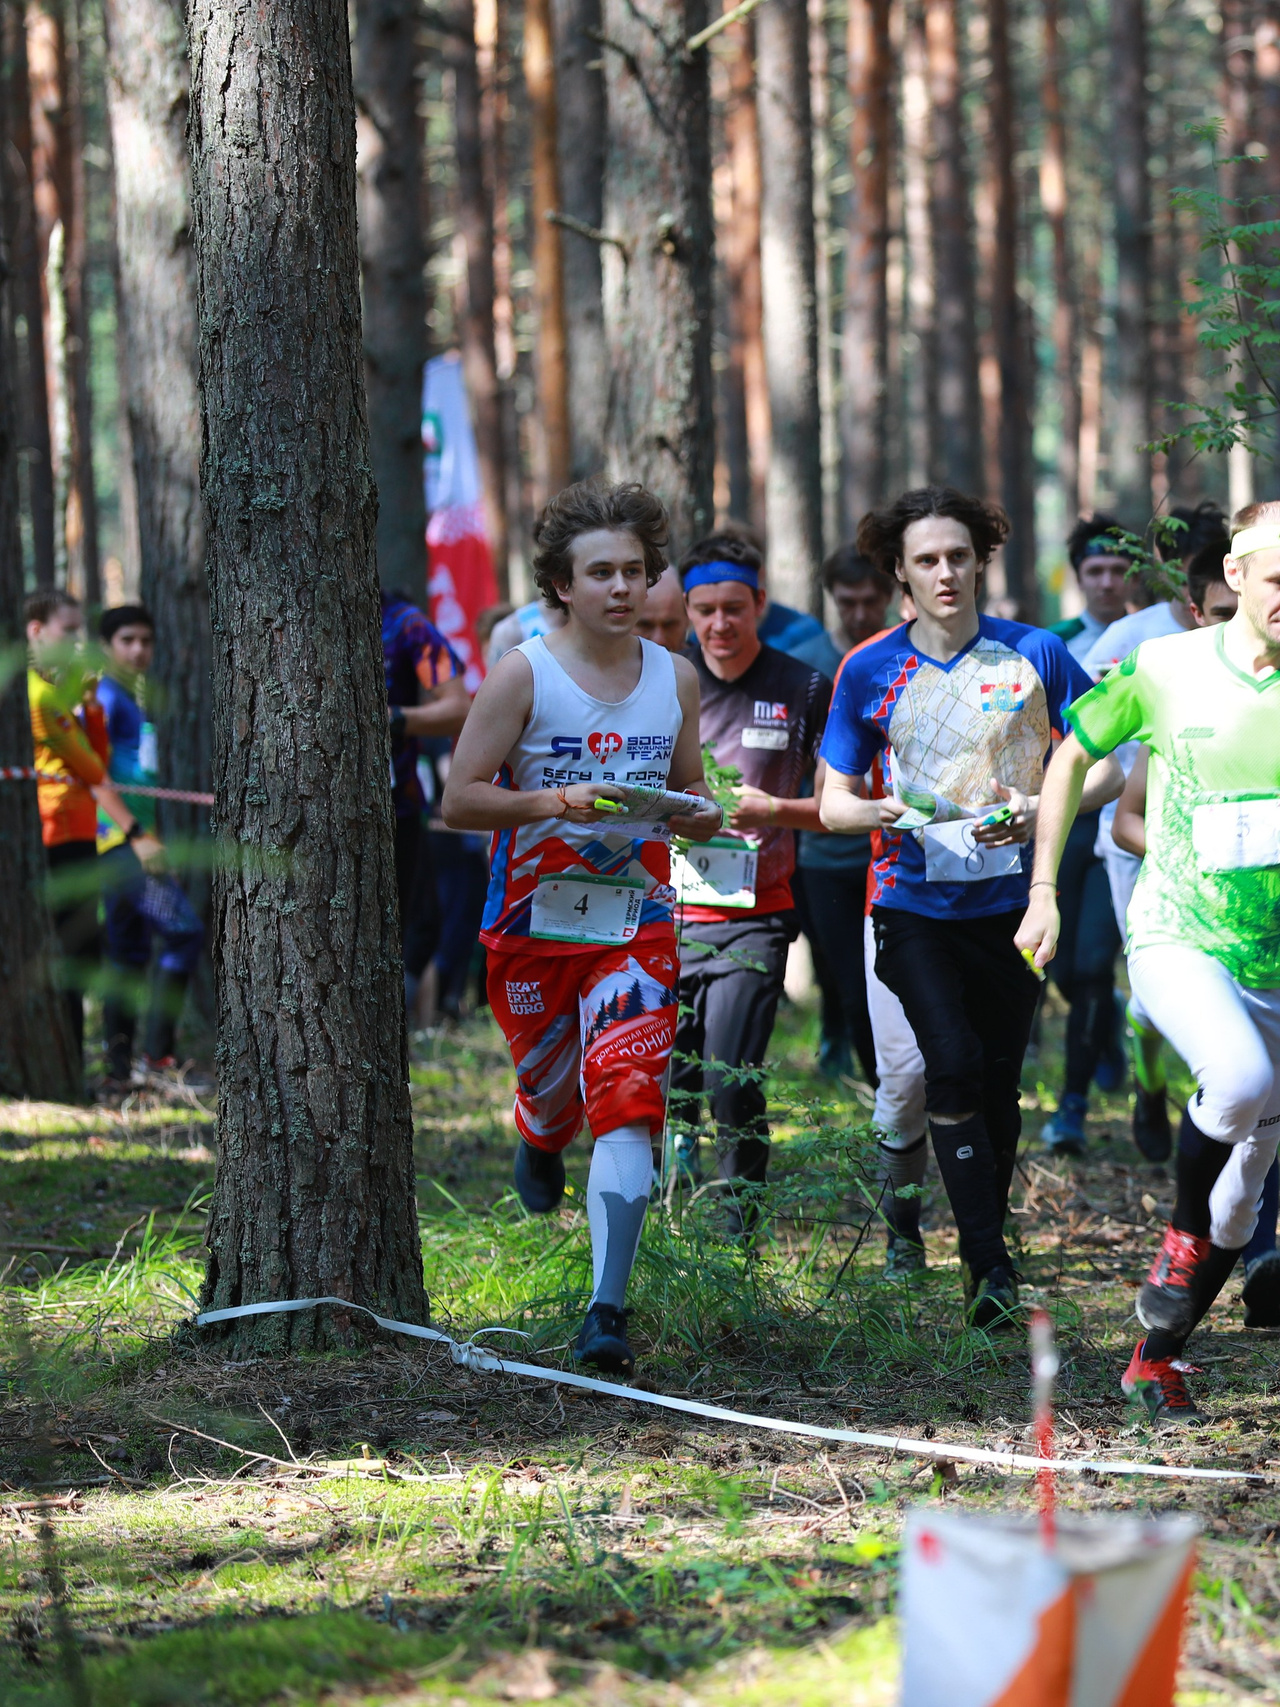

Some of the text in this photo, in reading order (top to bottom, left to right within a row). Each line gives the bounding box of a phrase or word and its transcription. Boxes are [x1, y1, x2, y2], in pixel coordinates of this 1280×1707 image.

[627, 735, 673, 746] SOCHI
[547, 736, 582, 760] Я
[627, 751, 671, 760] TEAM
[543, 767, 592, 781] БЕГУ
[603, 772, 616, 781] В
[574, 893, 589, 916] 4
[625, 889, 635, 925] ПЕРМСКИЙ
[631, 898, 641, 926] ПЕРИОД
[505, 980, 540, 992] EKAT
[507, 990, 542, 1004] ERIN
[510, 1002, 545, 1015] BURG
[642, 1017, 669, 1034] ШКОЛА
